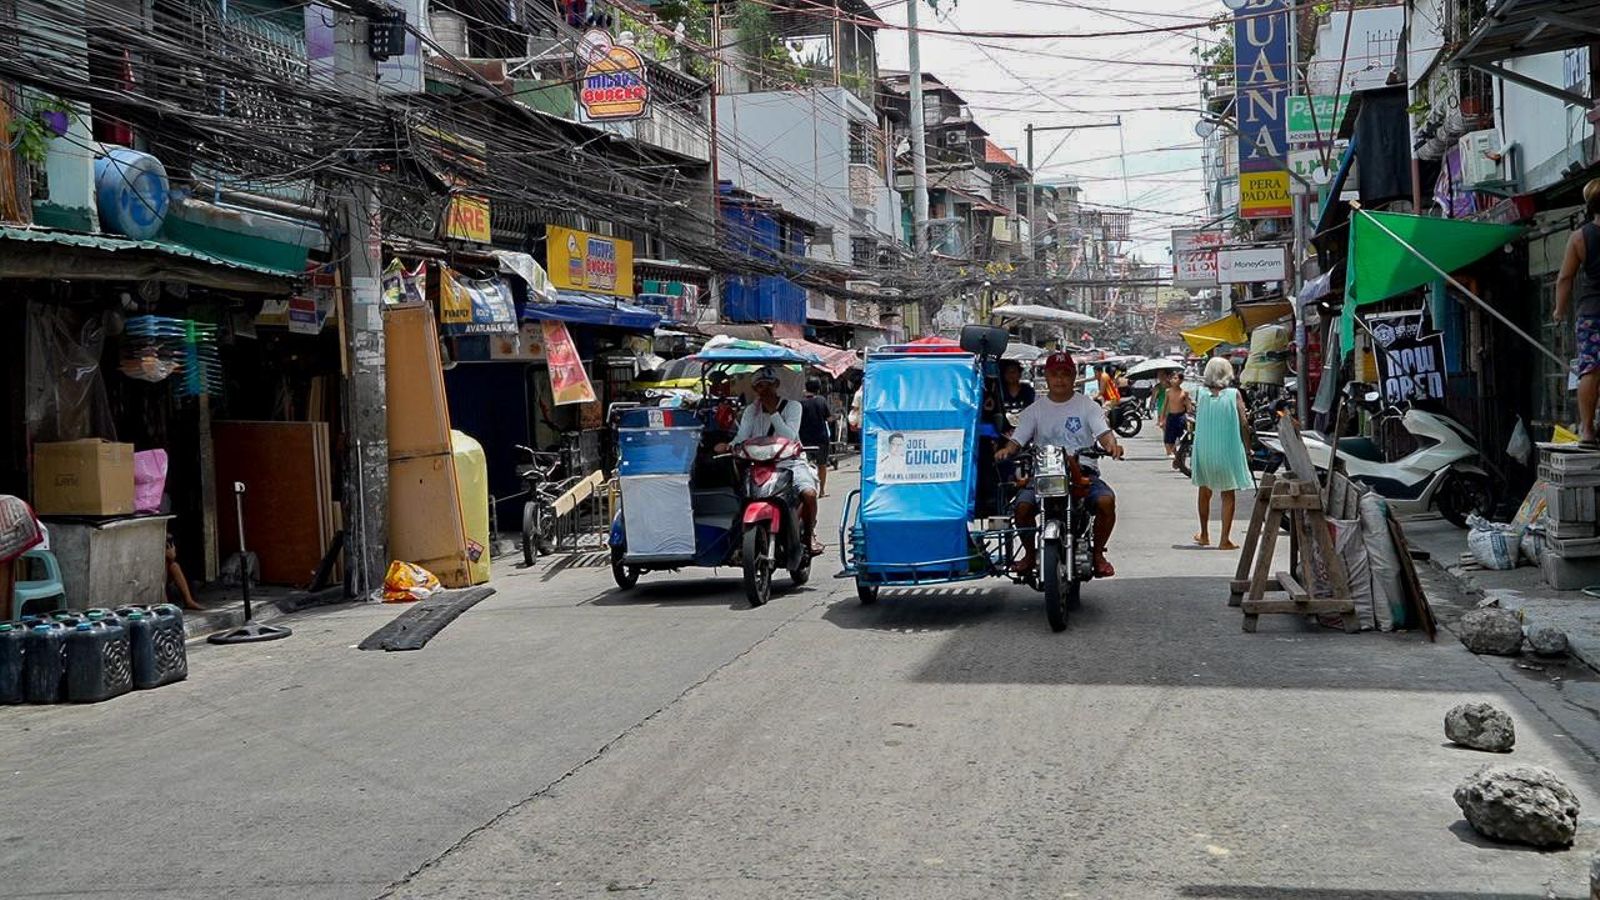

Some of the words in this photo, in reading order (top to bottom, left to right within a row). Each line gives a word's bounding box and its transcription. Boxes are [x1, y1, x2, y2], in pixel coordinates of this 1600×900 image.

[1243, 0, 1281, 158] UANA
[1249, 179, 1281, 190] PERA
[1242, 190, 1290, 201] PADALA
[1234, 259, 1281, 270] MoneyGram
[1386, 345, 1435, 377] NOW
[906, 439, 927, 449] JOEL
[905, 449, 958, 465] GUNGON
